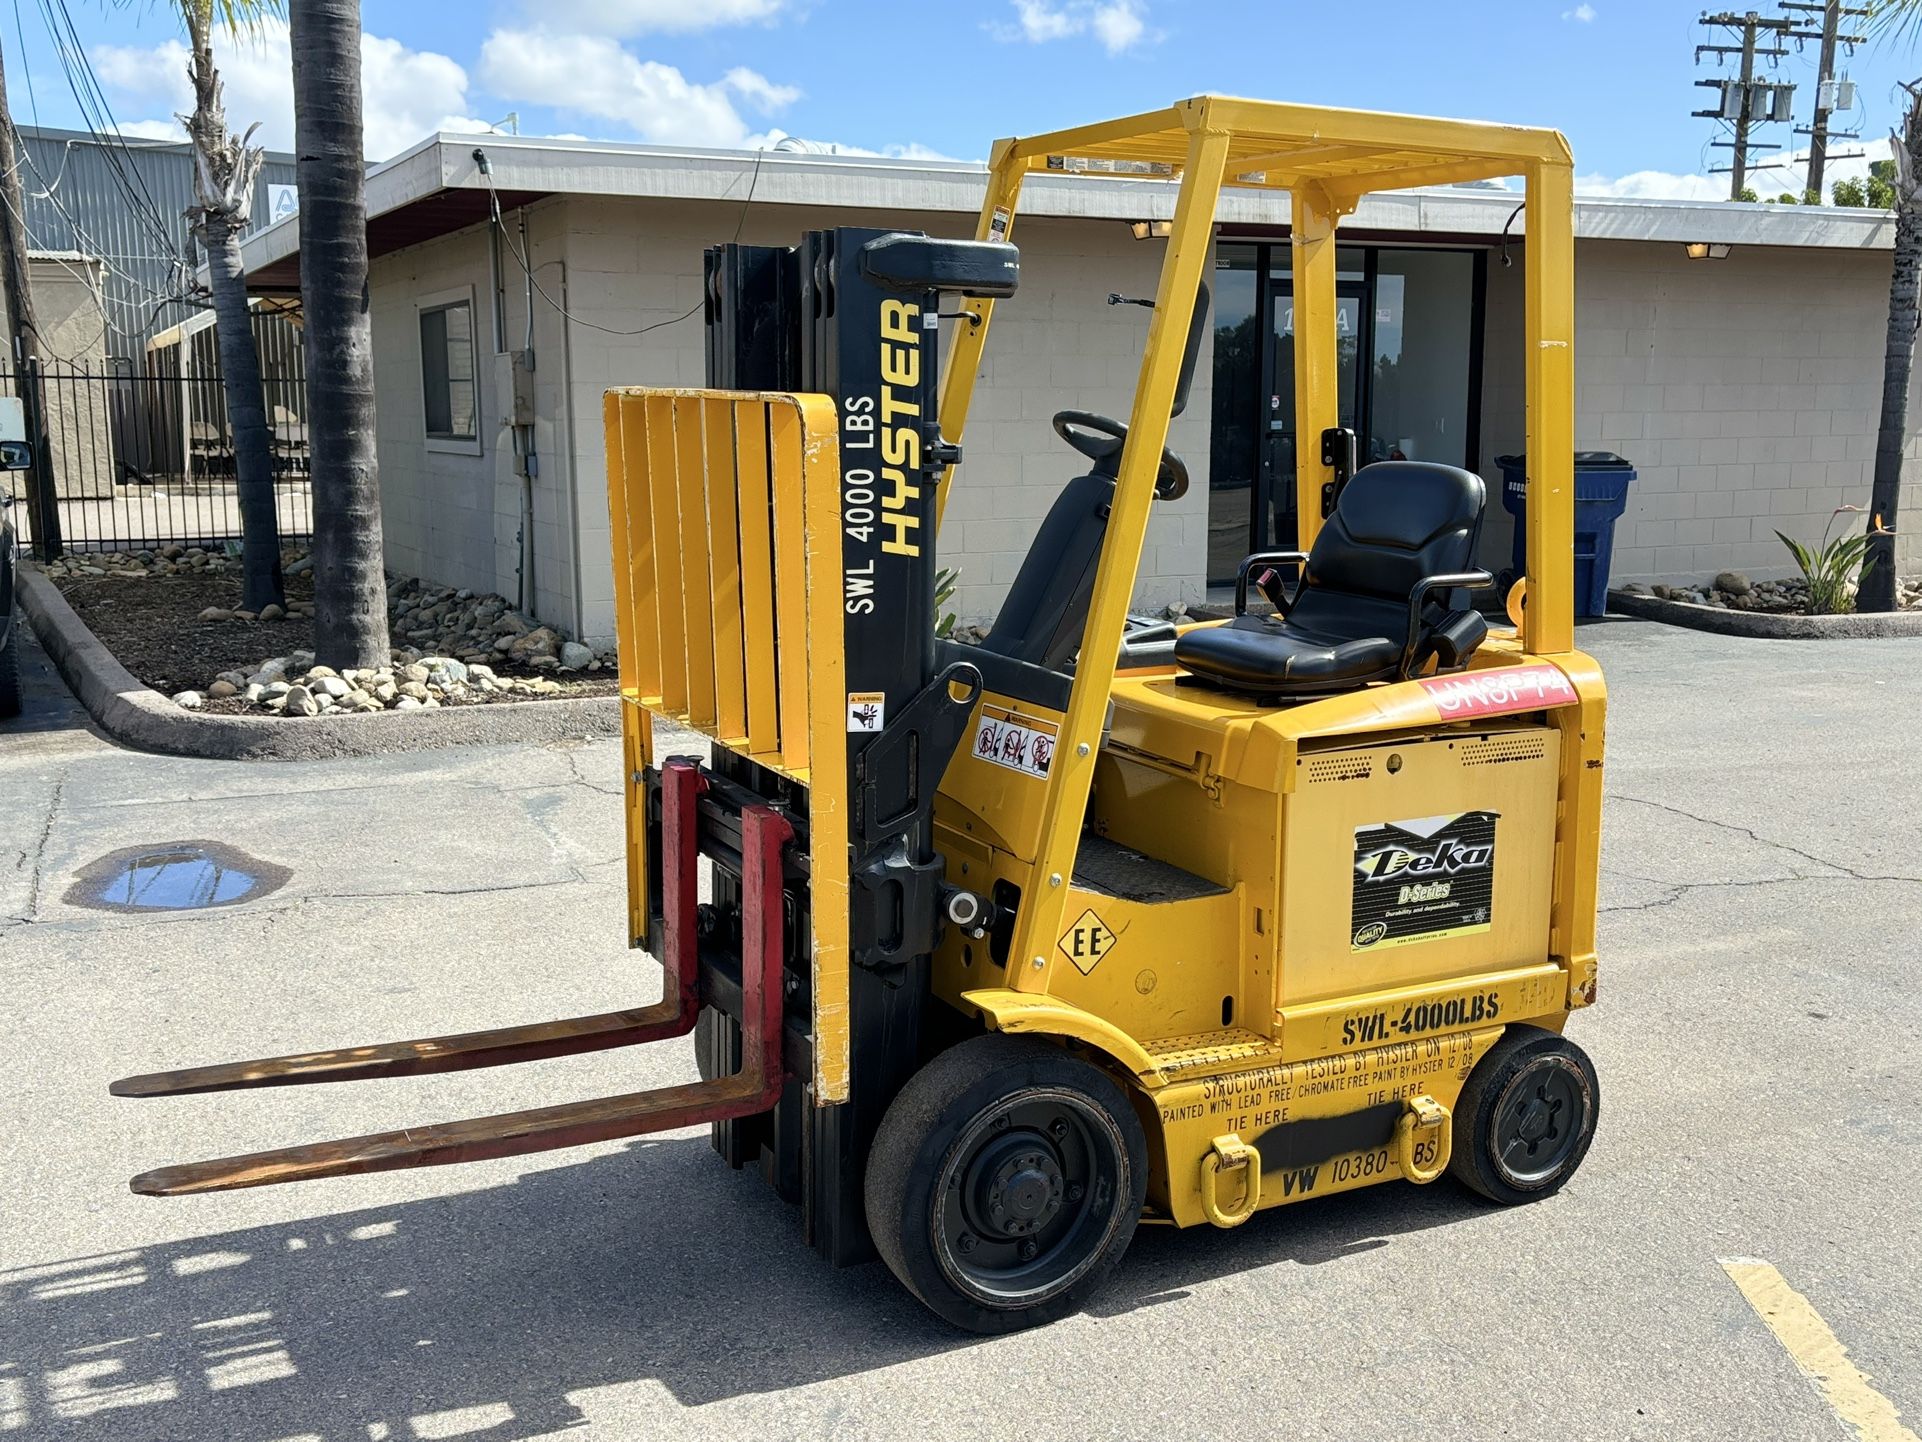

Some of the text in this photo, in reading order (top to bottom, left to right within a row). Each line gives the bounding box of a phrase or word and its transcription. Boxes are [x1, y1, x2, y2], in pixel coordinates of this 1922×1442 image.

[880, 297, 920, 558] HYSTER
[845, 394, 875, 616] SWL 4000 LBS
[857, 695, 882, 703] WARNING
[1369, 841, 1491, 879] Deka
[1398, 882, 1451, 905] D-Series
[1357, 925, 1383, 943] QUALITY
[1203, 1064, 1295, 1100] STRUCTURALLY
[1305, 1055, 1347, 1081] TESTED
[1354, 1052, 1369, 1072] BY
[1376, 1041, 1419, 1068] HYSTER
[1426, 1037, 1441, 1058] ON
[1162, 1104, 1204, 1125] PAINTED
[1210, 1098, 1232, 1115] WITH
[1238, 1092, 1262, 1110] LEAD
[1347, 1074, 1369, 1089] FREE
[1372, 1067, 1397, 1085] PAINT
[1400, 1065, 1410, 1078] BY
[1412, 1059, 1443, 1076] HYSTER
[1366, 1081, 1425, 1106] TIE HERE
[1226, 1108, 1289, 1133] TIE HERE
[1282, 1165, 1320, 1197] VW
[1332, 1150, 1388, 1184] 10380
